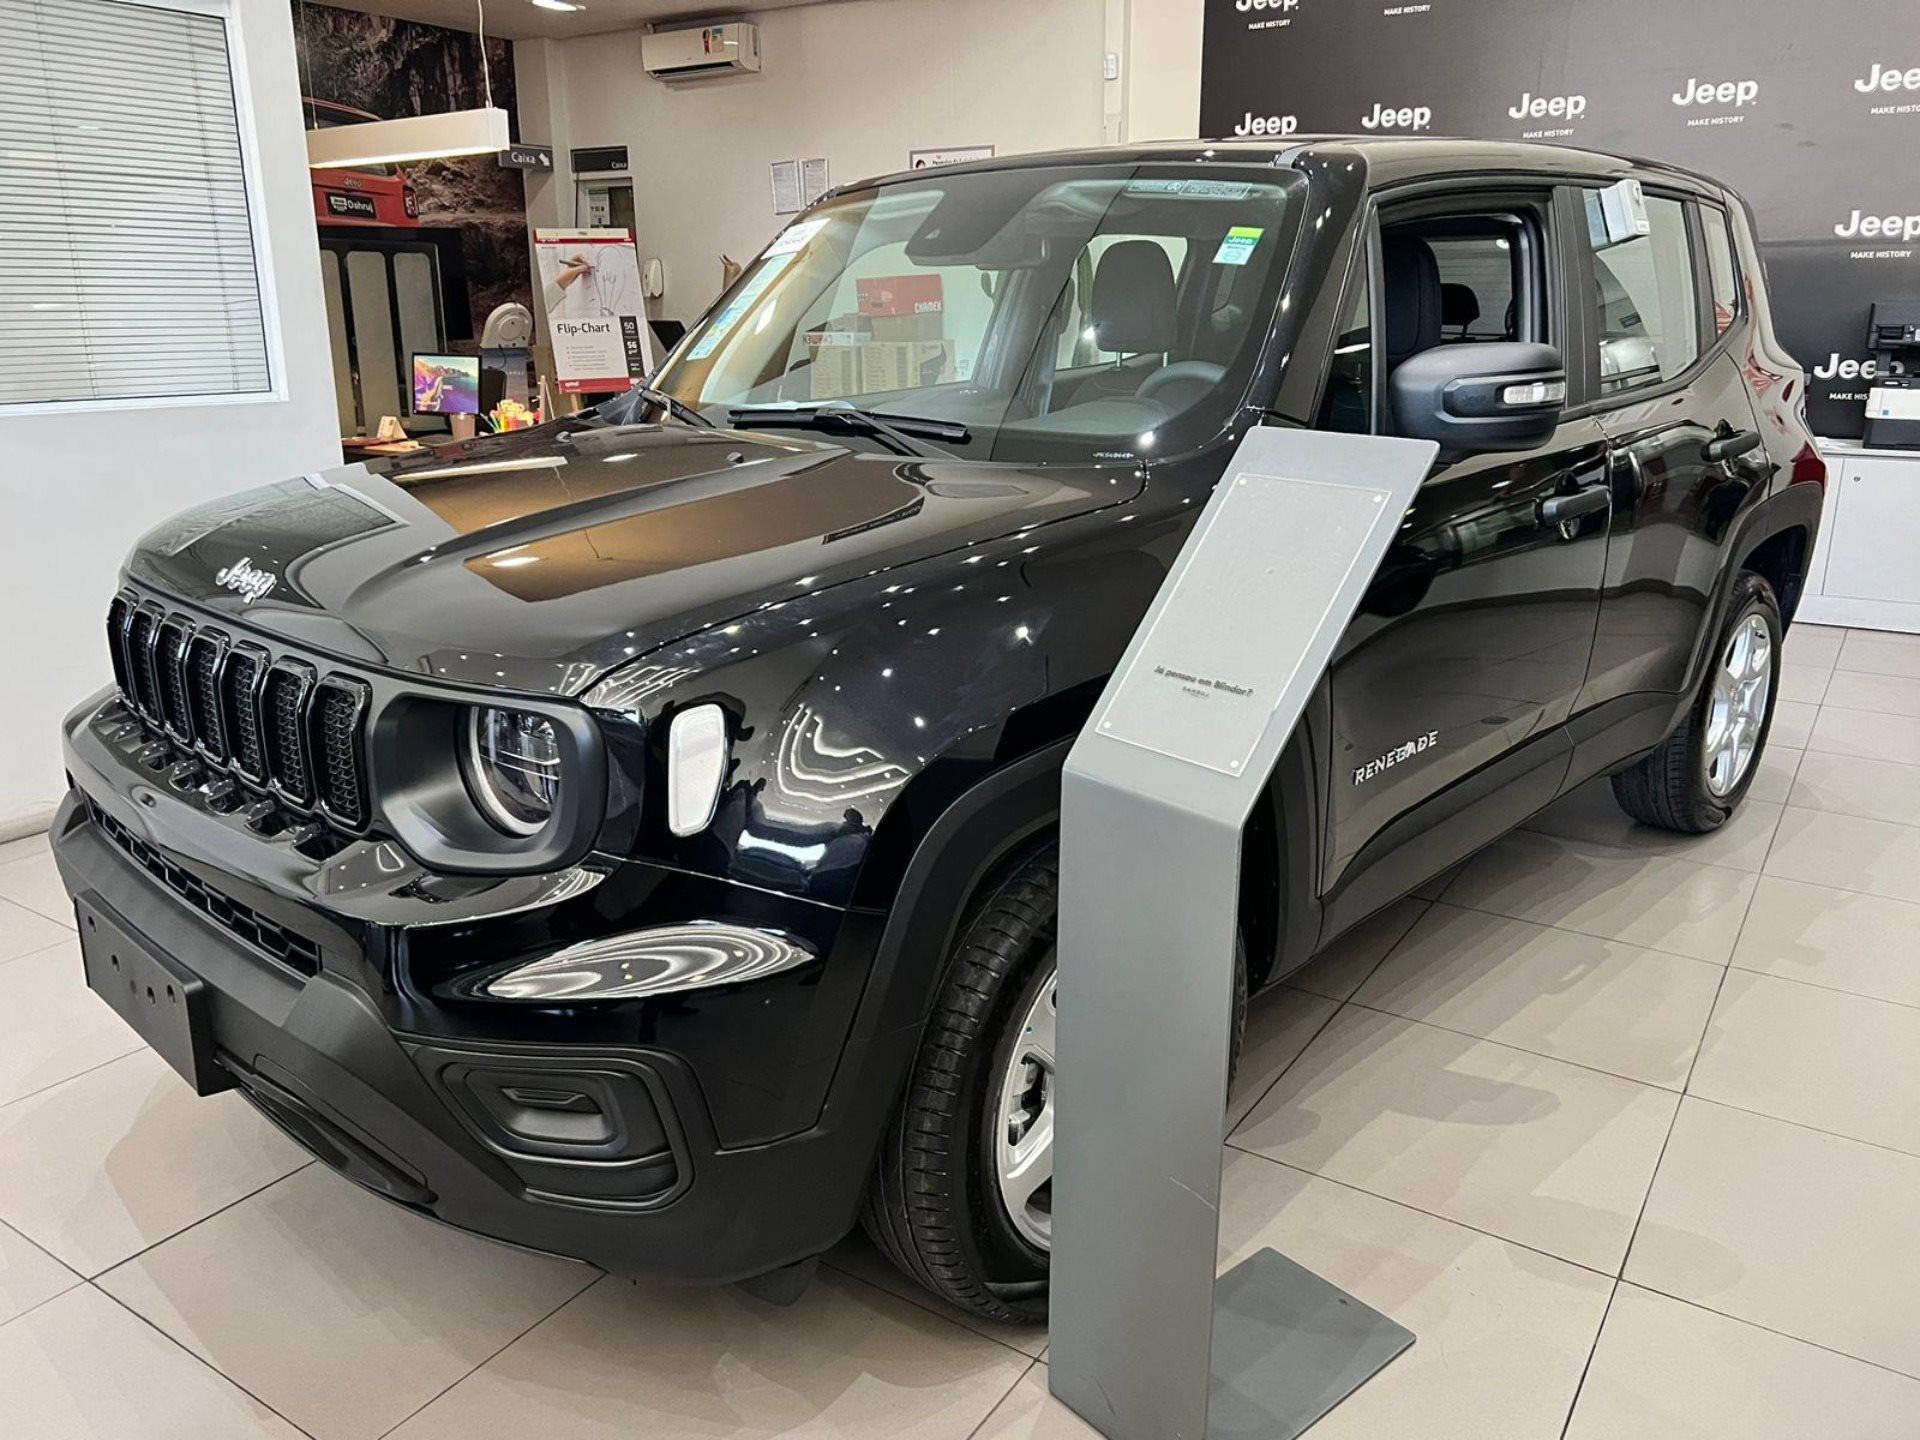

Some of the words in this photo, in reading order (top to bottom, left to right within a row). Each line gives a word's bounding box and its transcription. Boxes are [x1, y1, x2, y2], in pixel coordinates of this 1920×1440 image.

[1384, 7, 1402, 16] MAKE
[1403, 4, 1431, 14] HISTORY
[1248, 21, 1265, 30] MAKE
[1265, 19, 1291, 28] HISTORY
[1672, 78, 1758, 107] Jeep
[1508, 93, 1586, 120] Jeep
[1871, 106, 1896, 115] MAKE
[1234, 112, 1297, 135] Jeep
[1361, 103, 1431, 130] Jeep
[1687, 117, 1710, 127] MAKE
[1710, 115, 1744, 125] HISTORY
[1522, 130, 1542, 139] MAKE
[1543, 128, 1574, 137] HISTORY
[511, 151, 536, 164] Caixa
[1834, 209, 1920, 241] Jeep
[1850, 251, 1875, 259] MAKE
[1875, 250, 1912, 258] HISTORY
[556, 322, 611, 337] Flip-Chart
[1829, 393, 1853, 401] MAKE
[216, 556, 276, 605] Jeep
[1354, 730, 1439, 786] RENEGADE
